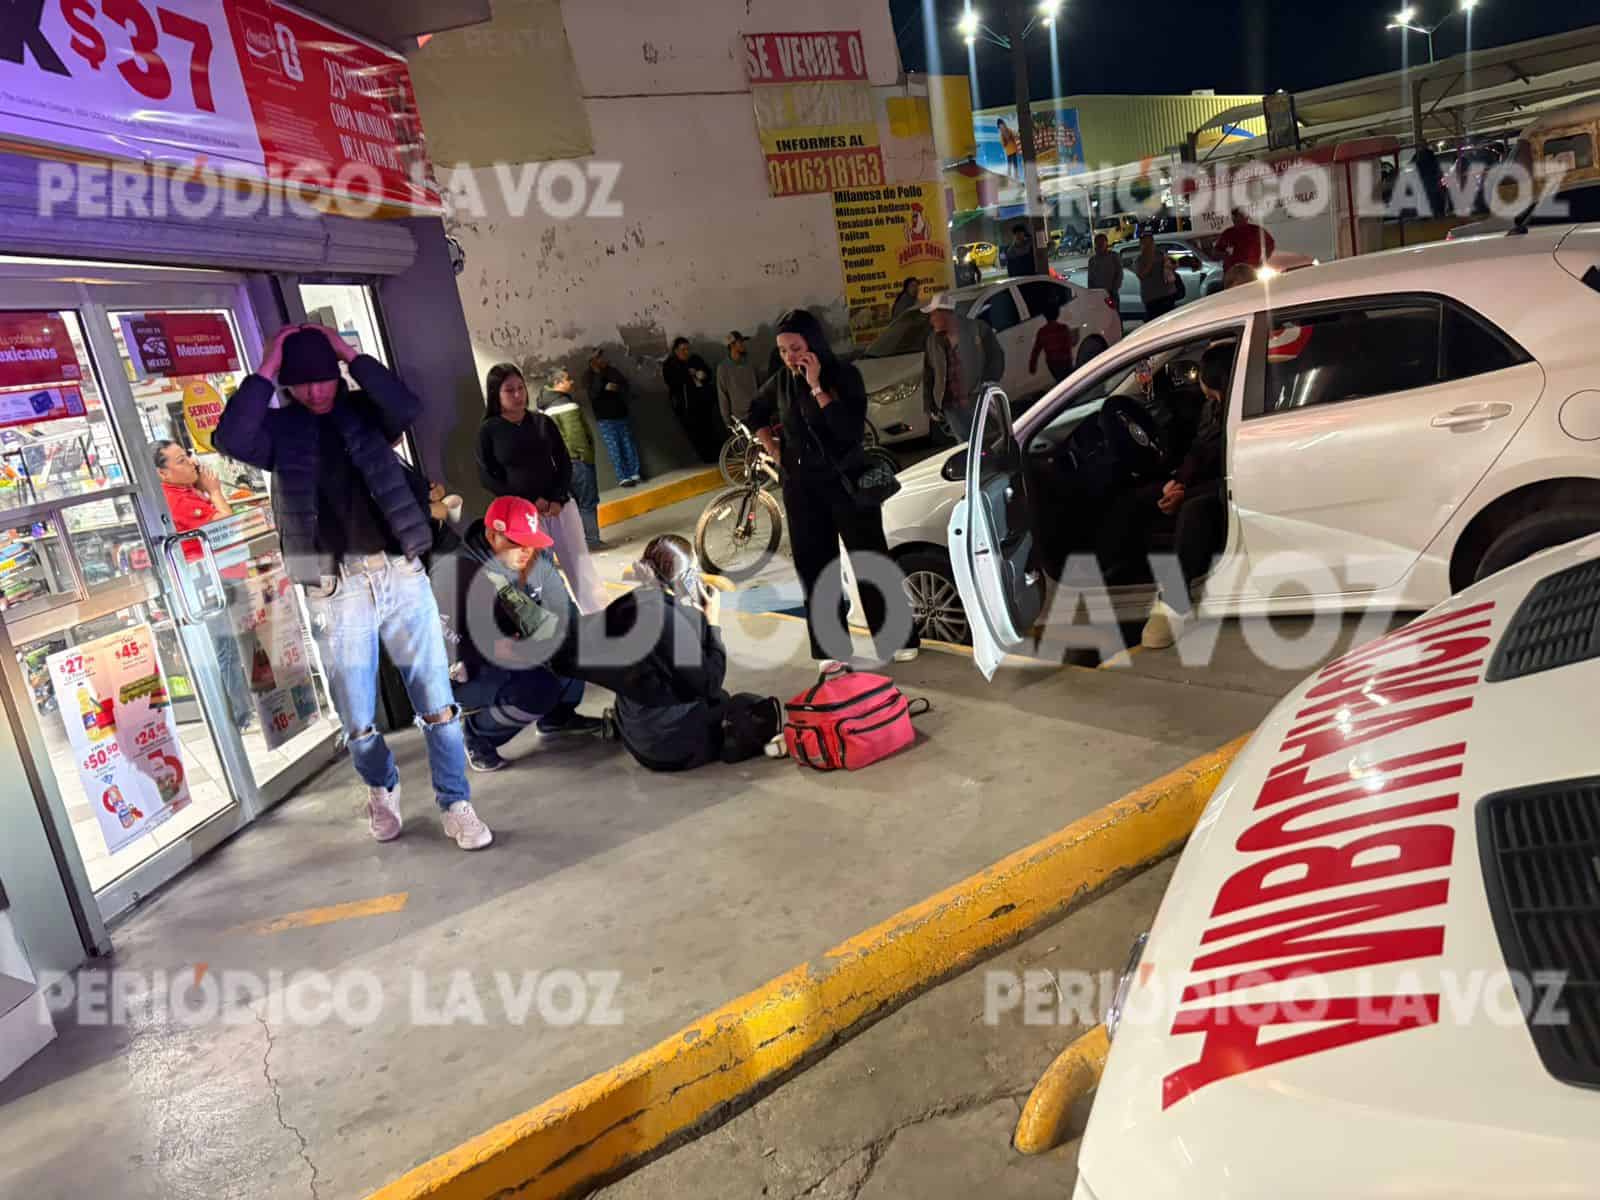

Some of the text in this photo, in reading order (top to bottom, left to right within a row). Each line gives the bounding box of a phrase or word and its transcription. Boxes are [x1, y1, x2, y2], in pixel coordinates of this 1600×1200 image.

[743, 36, 773, 79] SE
[774, 35, 845, 78] VENDE
[776, 134, 864, 152] INFORMES AL
[834, 185, 922, 203] Milanesa de Pollo
[842, 244, 885, 257] Palomitas
[845, 258, 874, 269] Tender
[0, 348, 58, 362] exicanos
